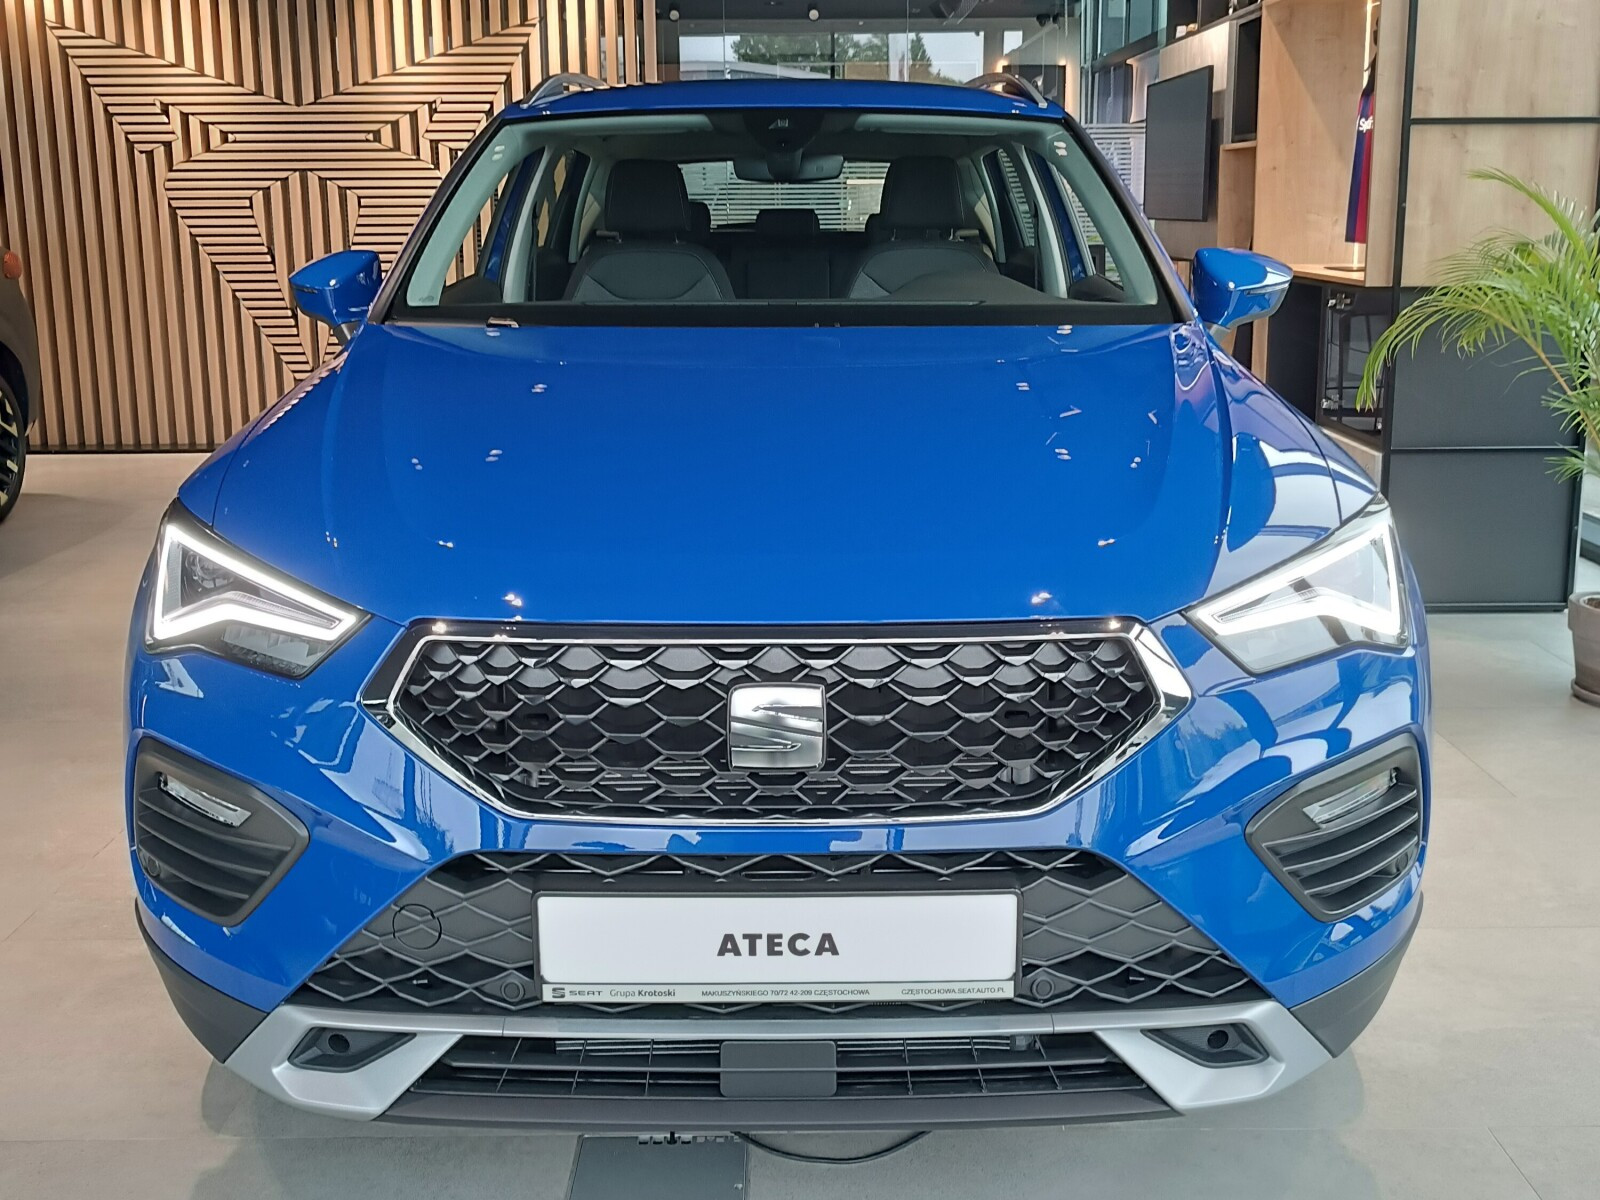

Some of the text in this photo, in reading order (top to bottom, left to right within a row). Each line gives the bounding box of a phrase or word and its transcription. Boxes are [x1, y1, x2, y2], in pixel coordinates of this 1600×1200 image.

[716, 932, 840, 957] ATECA
[609, 988, 636, 998] Grupa
[637, 988, 676, 997] Krotoski
[701, 989, 769, 997] MAKUSZYŃSKIEGO
[813, 989, 871, 997] CZĘSTOCHOWA
